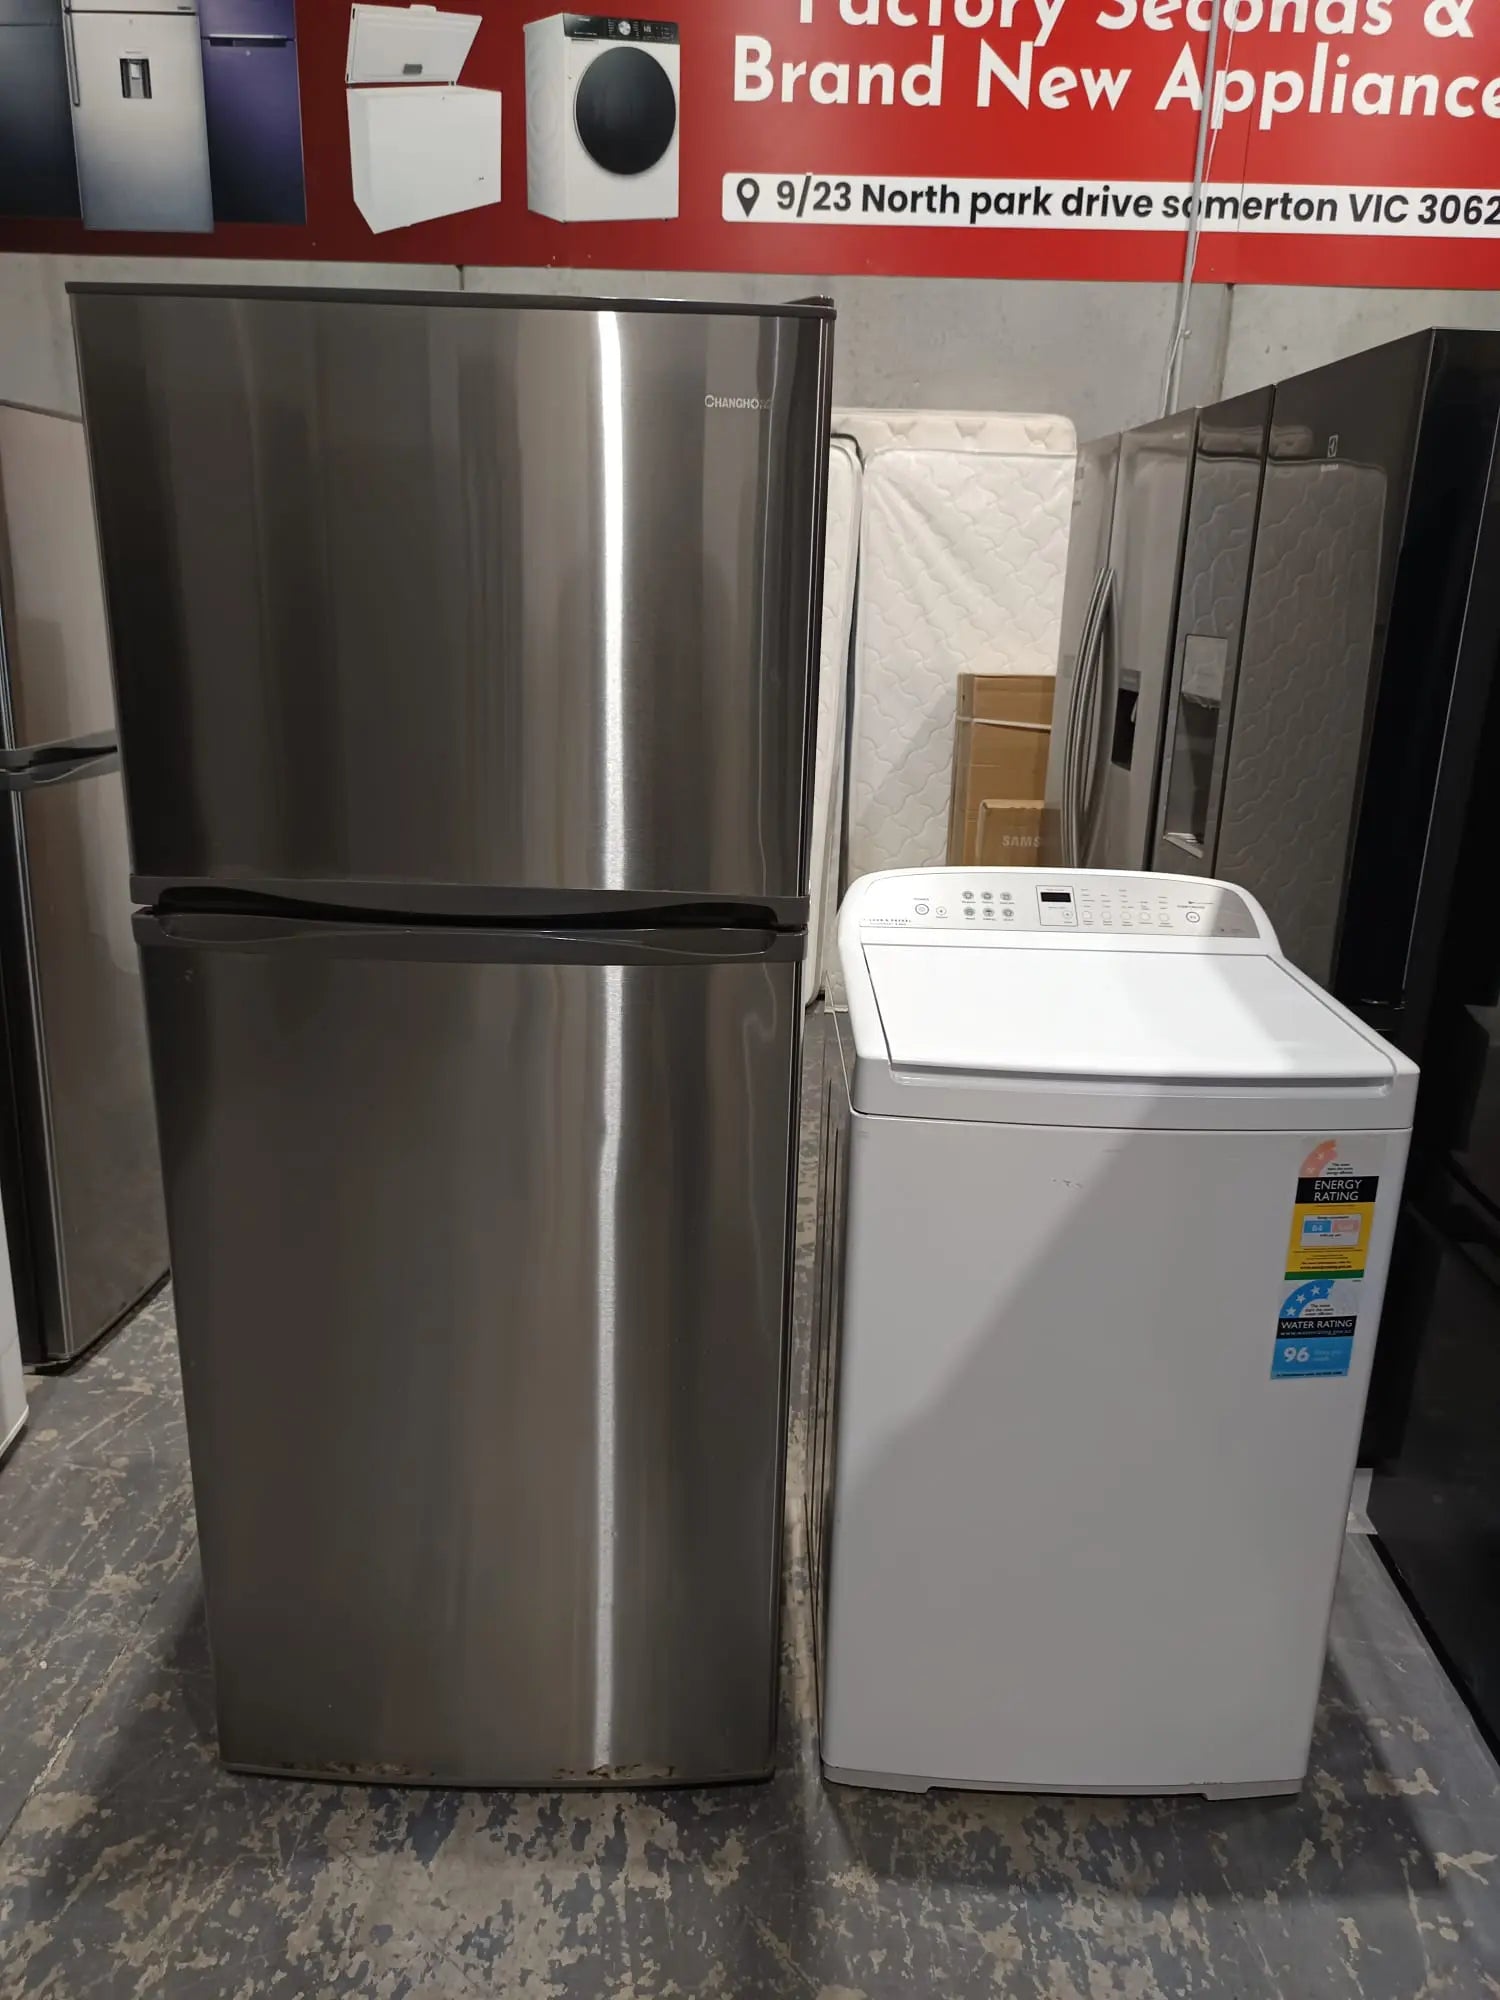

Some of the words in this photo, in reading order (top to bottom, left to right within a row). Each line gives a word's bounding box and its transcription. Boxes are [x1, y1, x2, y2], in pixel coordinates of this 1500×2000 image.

[1423, 0, 1475, 38] &
[733, 34, 945, 106] Brand
[976, 38, 1132, 111] New
[776, 173, 852, 218] 9/23
[862, 184, 960, 214] North
[970, 185, 1053, 224] park
[1062, 184, 1153, 218] drive
[1162, 192, 1338, 221] somerton
[1350, 193, 1410, 223] VIC
[1418, 194, 1500, 225] 3062
[704, 394, 773, 410] CHANGHO
[1314, 1179, 1362, 1190] ENERGY
[1313, 1191, 1359, 1201] RATING
[1281, 1321, 1314, 1329] WATER
[1317, 1319, 1353, 1329] RATING
[1283, 1347, 1310, 1362] 96
